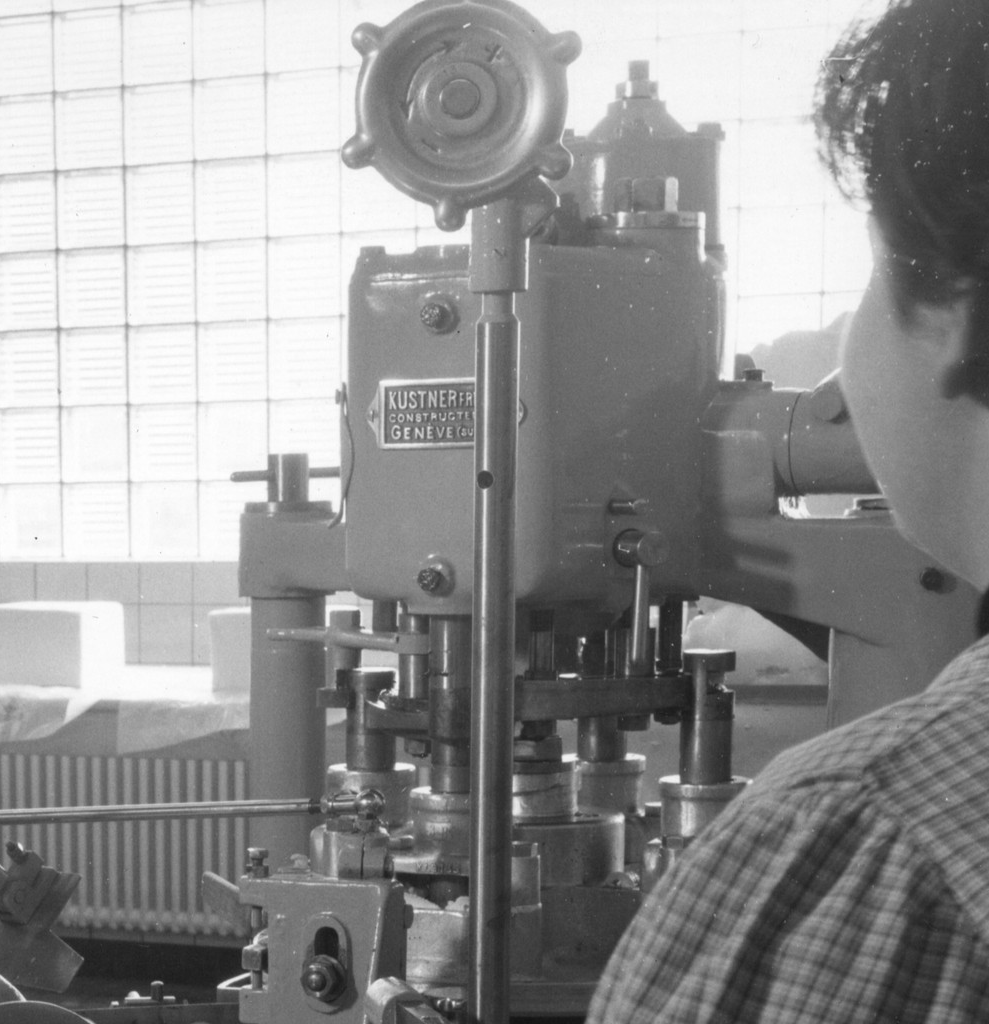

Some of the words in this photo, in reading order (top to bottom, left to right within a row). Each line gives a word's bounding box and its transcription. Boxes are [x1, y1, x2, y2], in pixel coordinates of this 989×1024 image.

[388, 390, 457, 410] KUSTNER
[459, 391, 476, 407] FR
[389, 411, 476, 423] CONSTRUCTE
